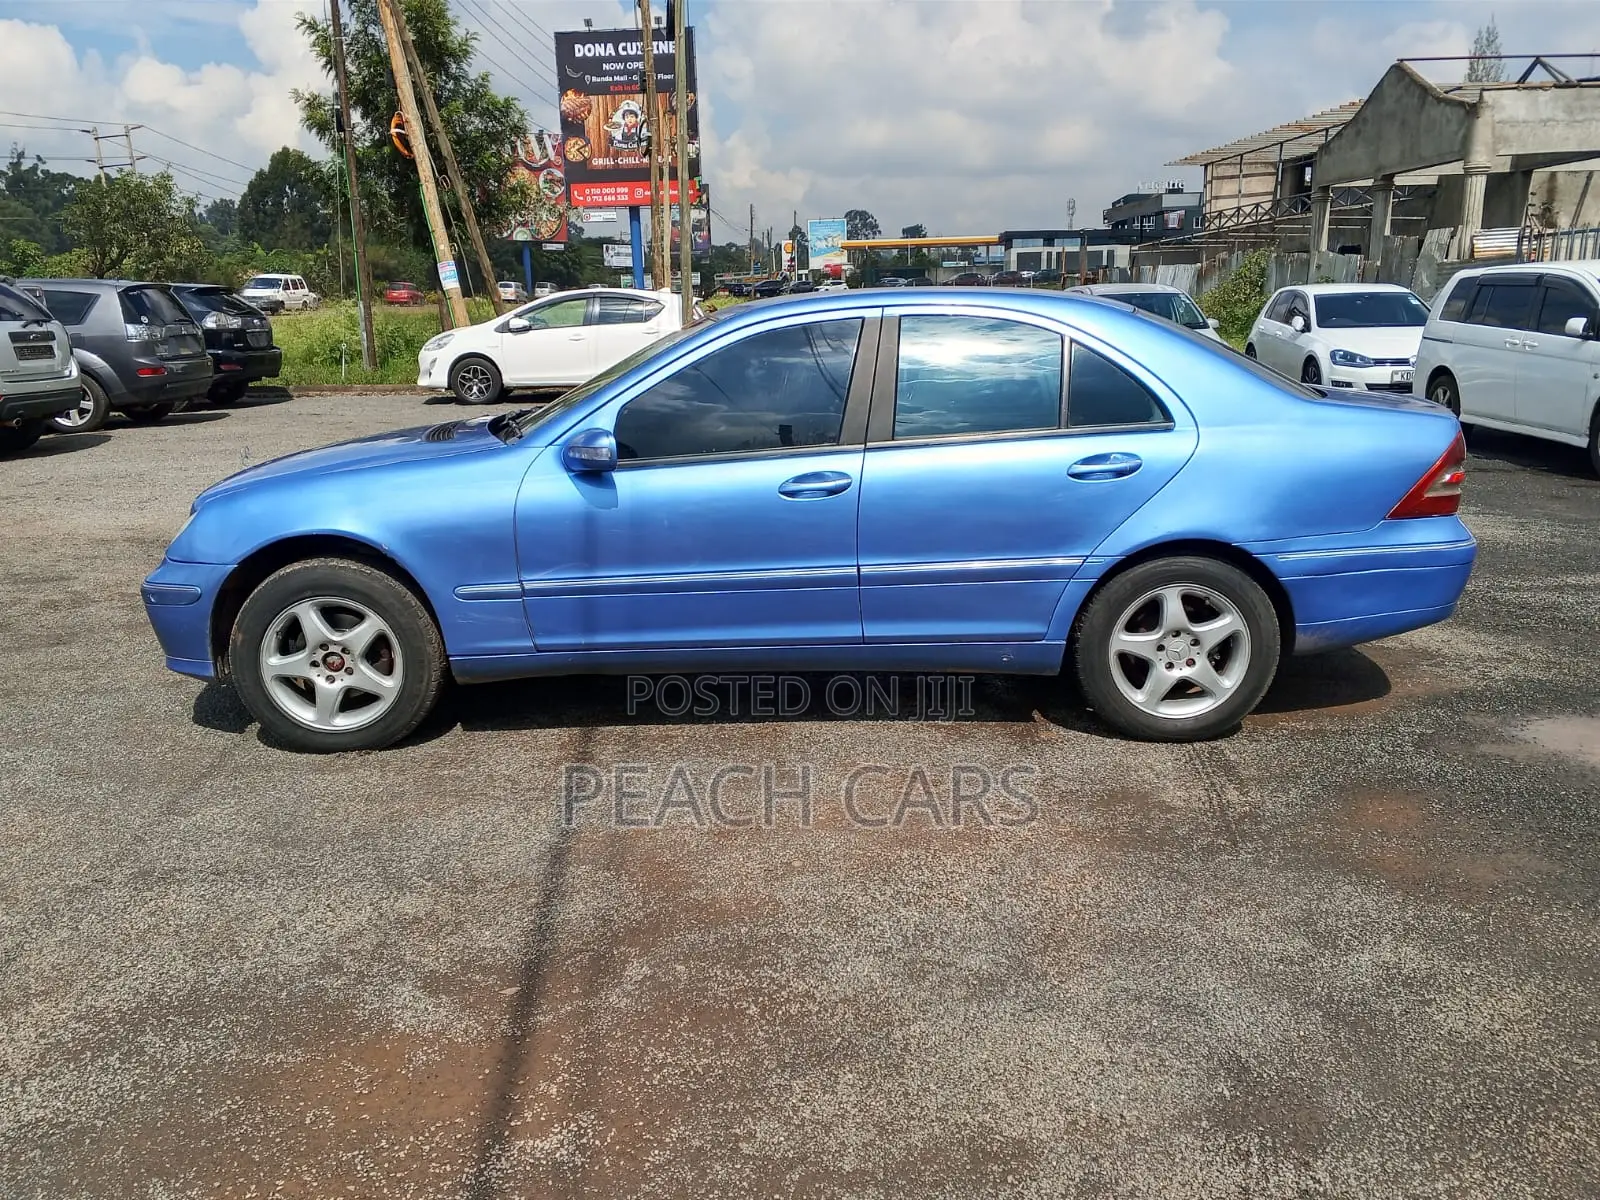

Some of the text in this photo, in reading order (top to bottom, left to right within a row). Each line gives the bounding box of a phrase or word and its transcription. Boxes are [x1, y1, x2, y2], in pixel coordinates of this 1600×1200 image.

[574, 41, 676, 58] DONA CUIINE
[602, 62, 645, 71] NOW OPE
[613, 74, 628, 82] Mall
